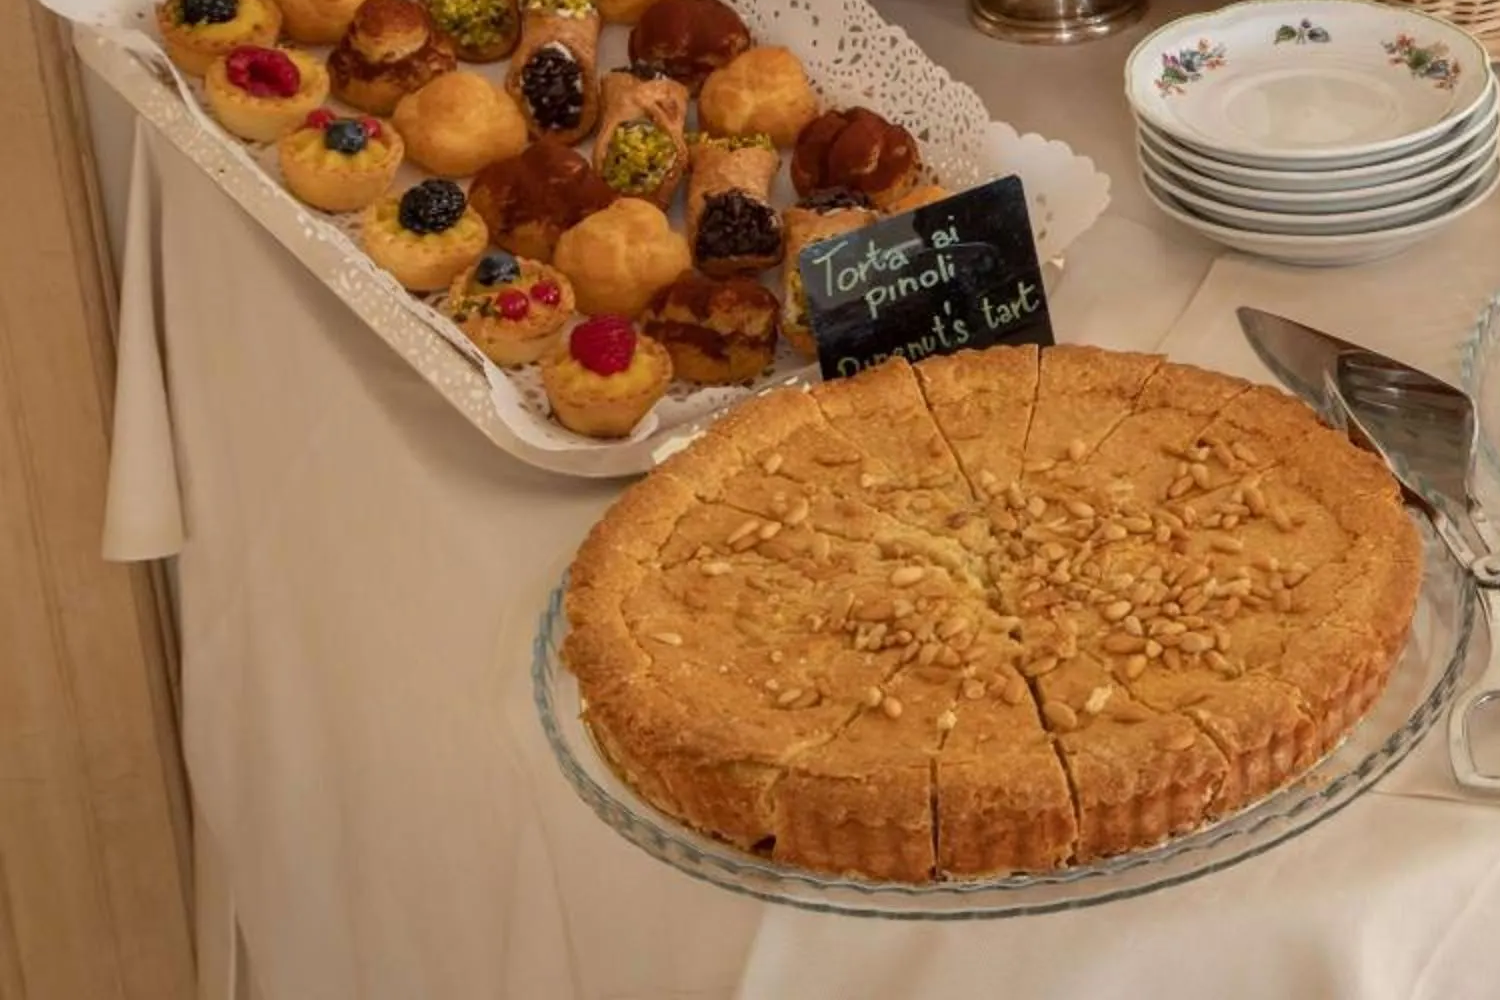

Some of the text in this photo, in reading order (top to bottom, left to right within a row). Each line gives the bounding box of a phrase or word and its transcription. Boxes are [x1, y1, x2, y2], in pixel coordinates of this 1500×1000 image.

[811, 215, 961, 297] Torta ai
[981, 281, 1040, 330] tart
